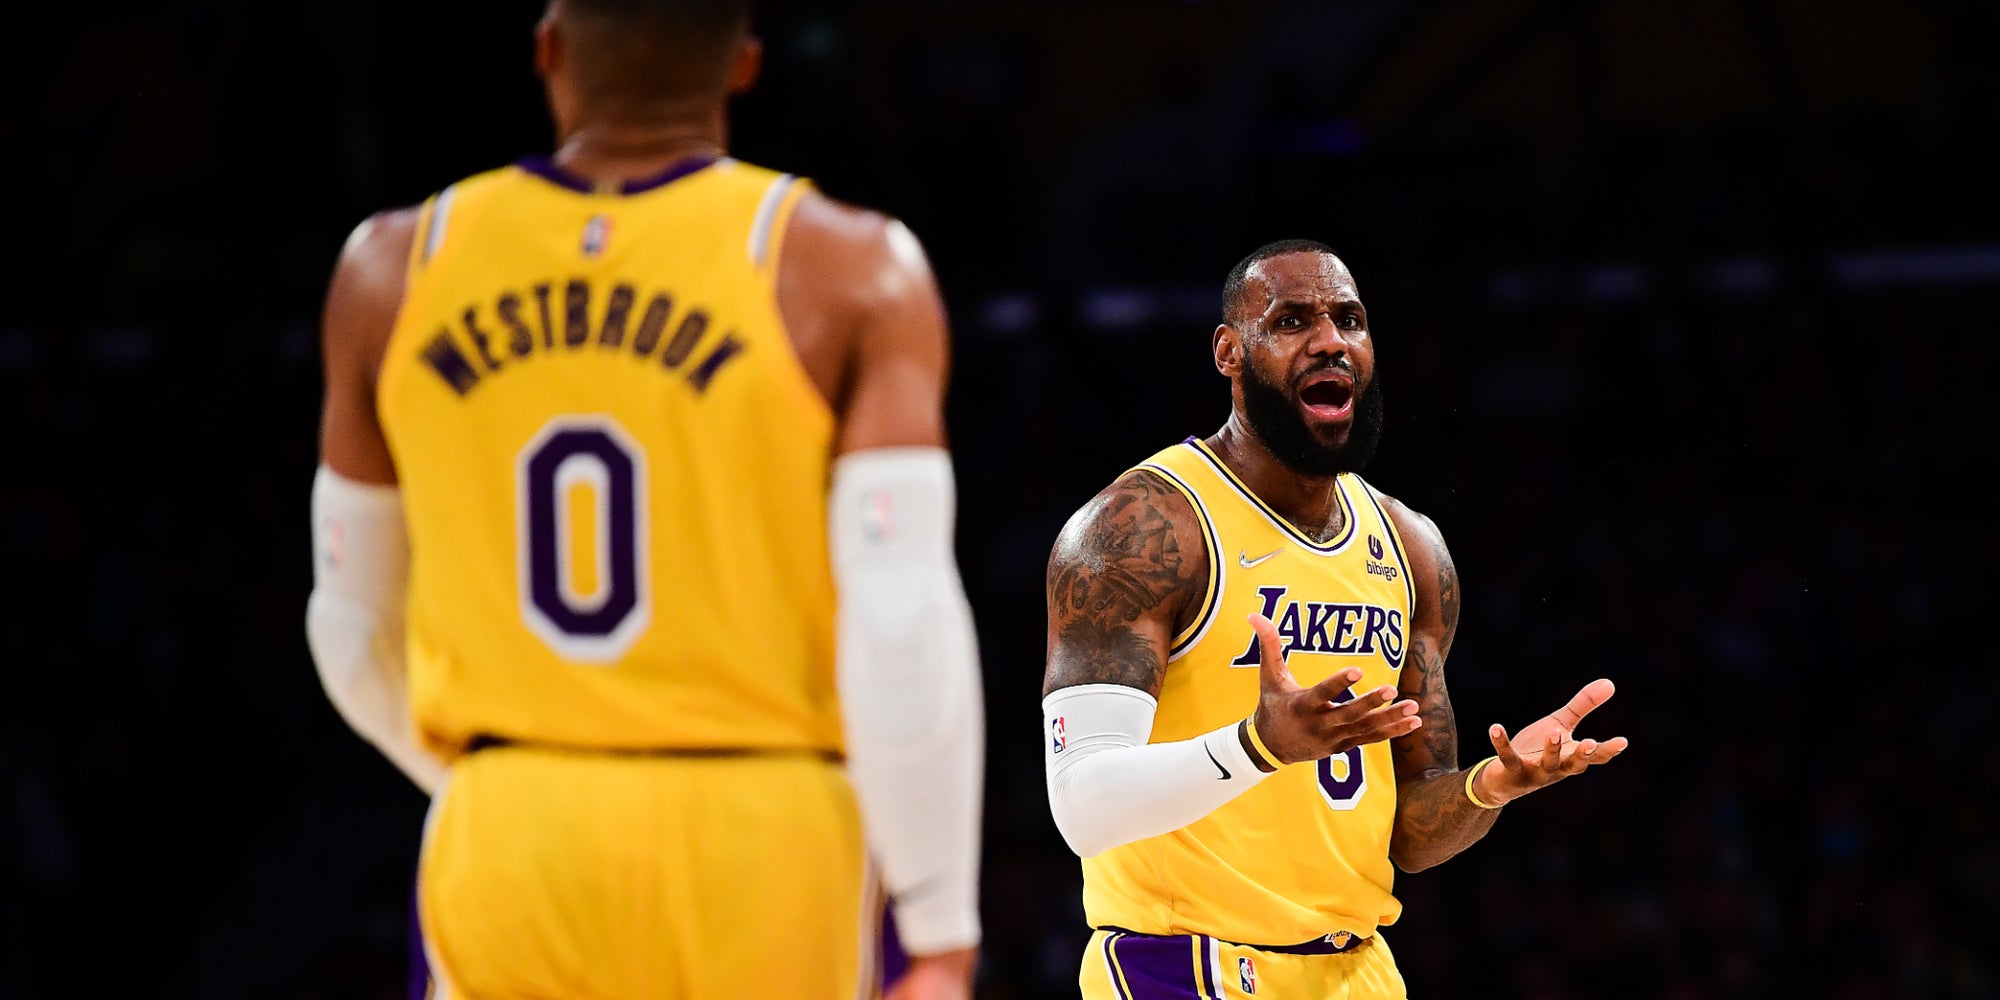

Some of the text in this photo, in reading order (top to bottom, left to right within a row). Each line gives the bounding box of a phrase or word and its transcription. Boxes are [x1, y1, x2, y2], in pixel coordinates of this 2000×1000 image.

[418, 279, 746, 398] WESTBROOK
[518, 416, 651, 660] 0
[1365, 560, 1397, 581] bibigo
[1230, 585, 1403, 670] LAKERS
